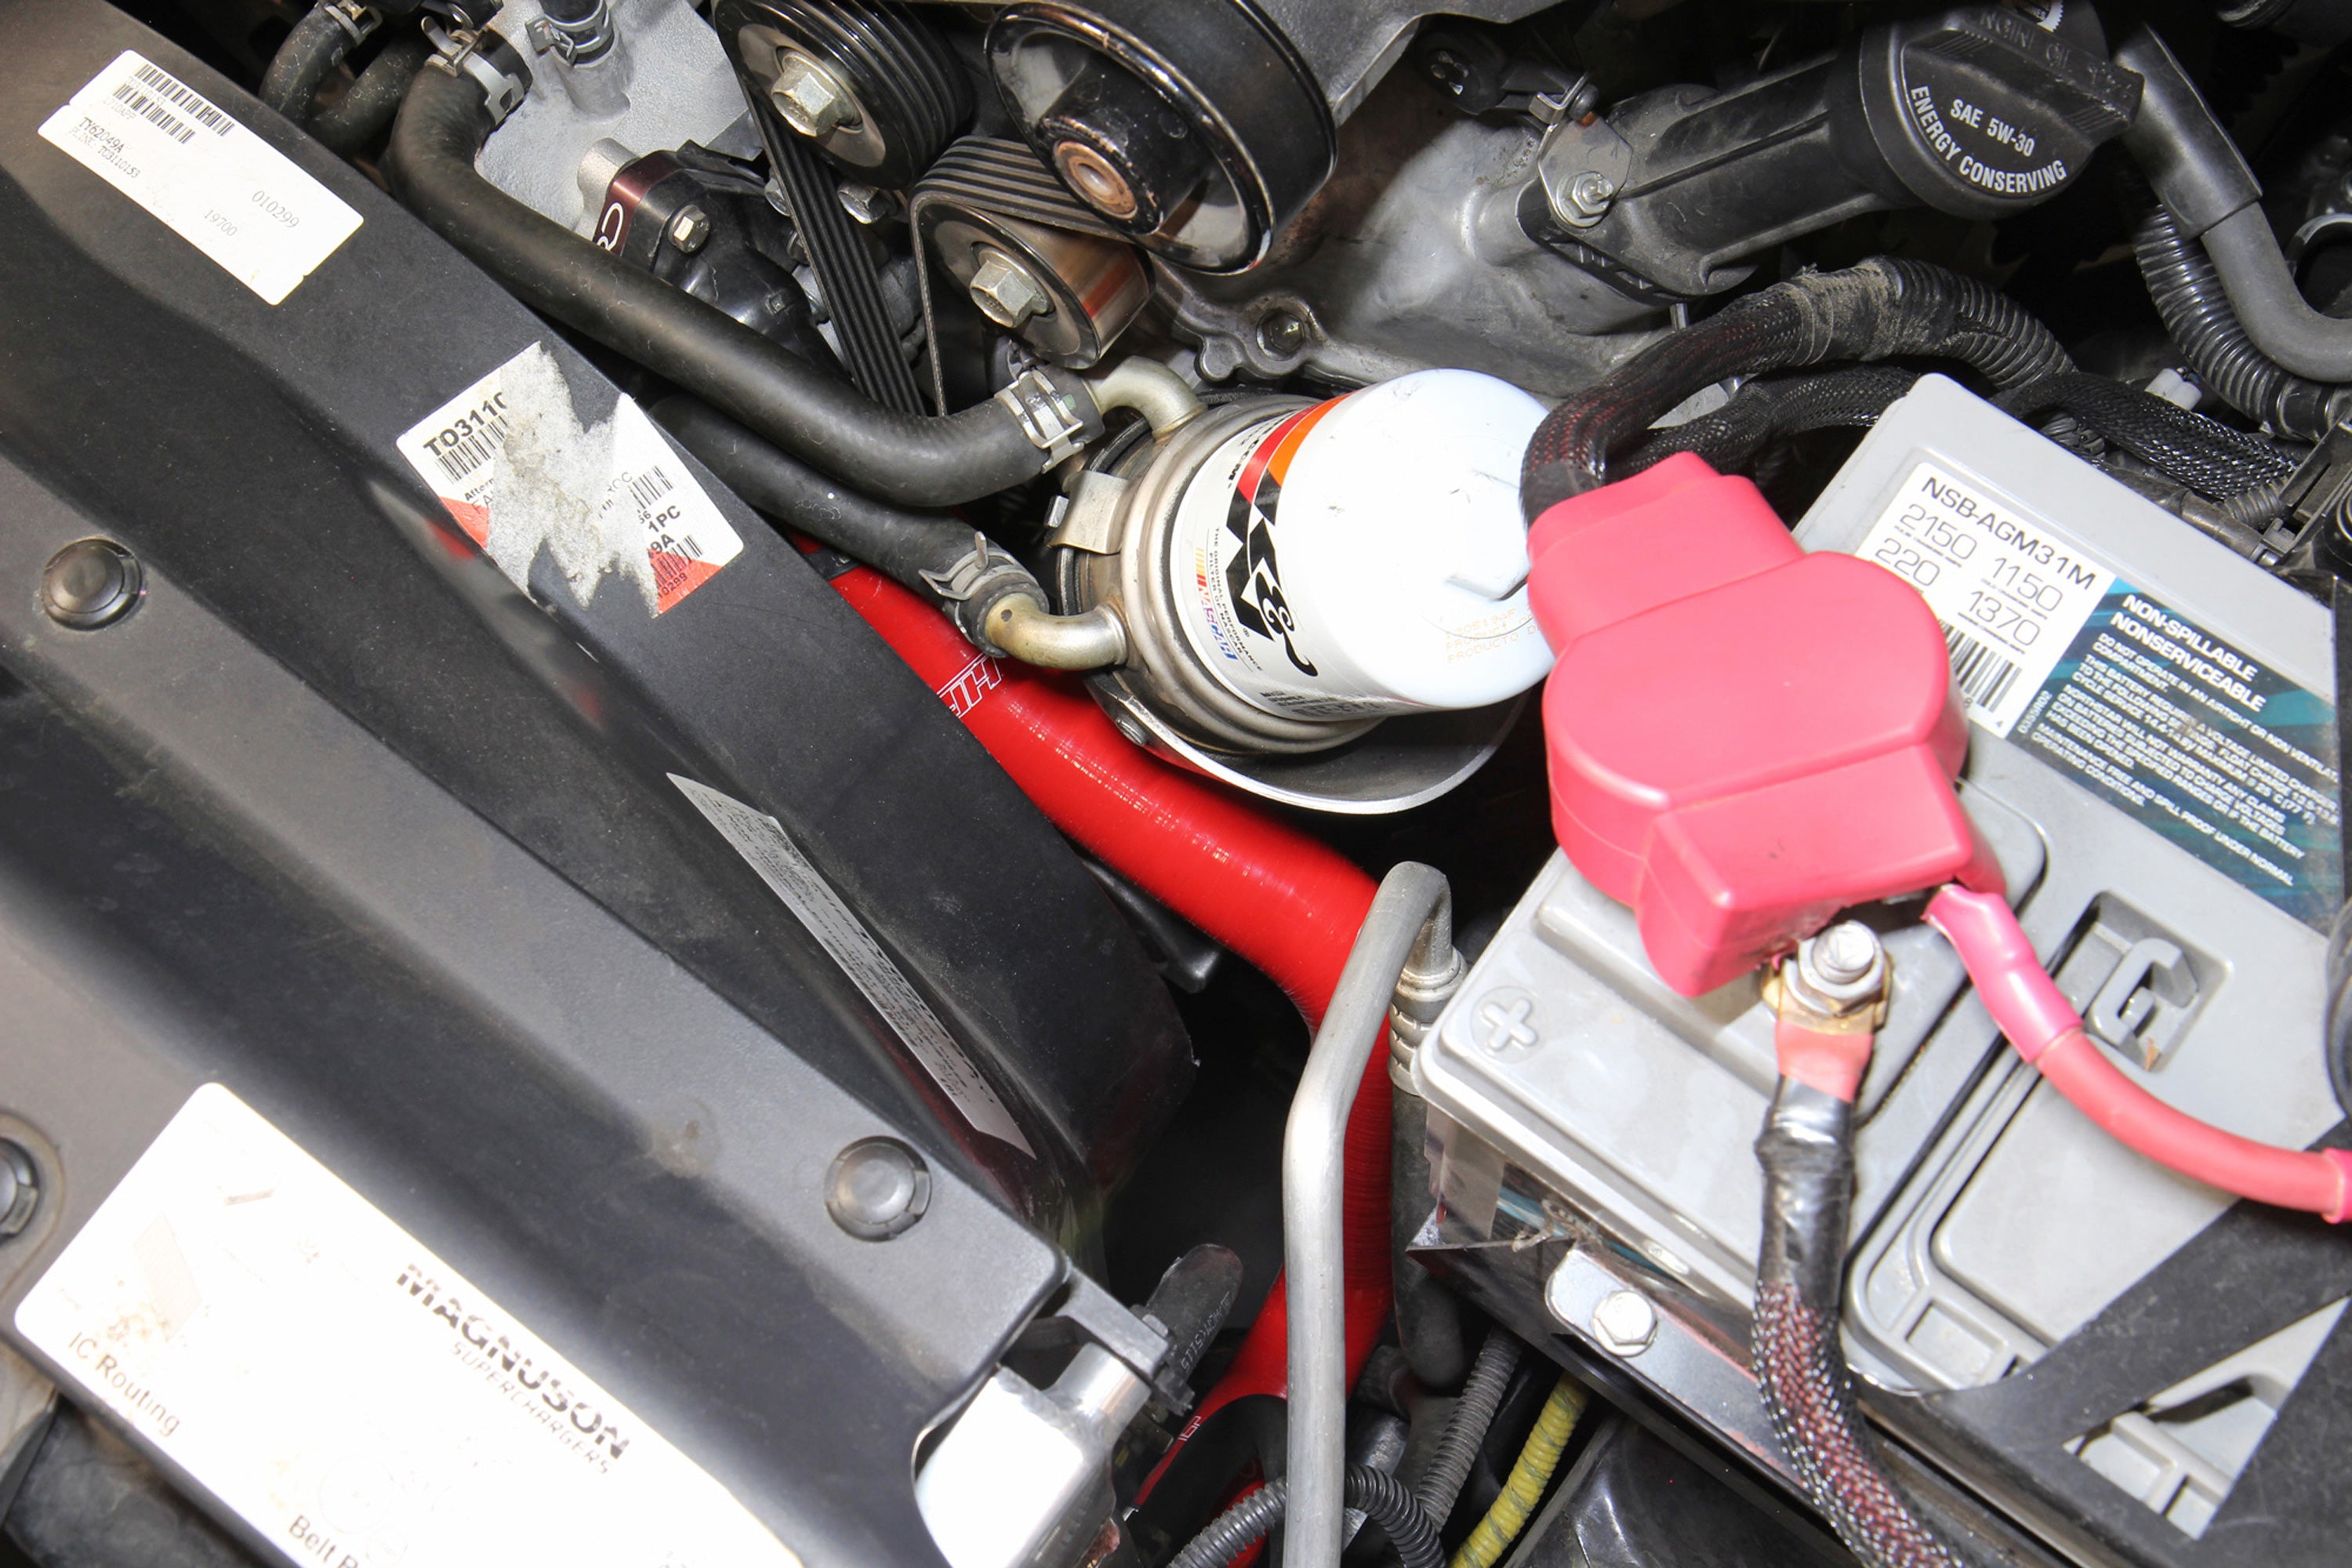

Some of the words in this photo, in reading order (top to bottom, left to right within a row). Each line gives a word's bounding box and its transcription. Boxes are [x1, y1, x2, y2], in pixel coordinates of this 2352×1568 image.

[78, 115, 125, 154] TY62049A
[1911, 85, 1962, 162] ENERGY
[1959, 155, 2067, 194] CONSERVING
[1949, 98, 1984, 129] SAE
[1987, 117, 2036, 158] 5W-30
[203, 207, 238, 238] 19700
[249, 188, 301, 231] 010299
[644, 503, 683, 535] 1PC
[1898, 500, 1980, 563] 2150
[1985, 553, 2064, 614] 1150
[1920, 474, 2096, 592] NSB-AGM31M
[1196, 575, 1238, 660] NASCAR
[1209, 552, 1218, 591] FILTER
[1215, 594, 1221, 608] OF
[1220, 612, 1243, 654] NASCAR
[1214, 550, 1224, 601] ORIGINAL
[1221, 603, 1263, 672] PERFORMANCE
[1874, 534, 1942, 589] 220
[1962, 586, 2042, 648] 1370
[2122, 591, 2258, 684] NON-SPILLABLE
[2091, 640, 2170, 693] COMPARTMENT.
[2097, 630, 2116, 648] DO
[2113, 640, 2137, 660] NOT
[2134, 653, 2180, 687] OPERATE
[2177, 679, 2192, 694] IN
[2189, 687, 2209, 704] AN
[2205, 696, 2252, 731] AIRTIGHT
[2248, 723, 2267, 740] OR
[2263, 732, 2292, 755] NON
[2109, 609, 2267, 713] NONSERVICEABLE
[1994, 718, 2003, 728] 4
[2030, 730, 2087, 770] OPERATING
[2083, 763, 2147, 807] CONDITIONS.
[2045, 709, 2069, 728] HAS
[2066, 722, 2095, 744] BEEN
[2092, 738, 2137, 770] OPENED.
[2056, 691, 2076, 708] ON
[2073, 701, 2126, 739] BATTERIES
[2123, 731, 2181, 772] SUBJECTED
[2178, 765, 2195, 781] TO
[2192, 774, 2235, 805] CHARGE
[2233, 799, 2286, 837] VOLTAGES
[2062, 682, 2124, 725] NORTHSTAR
[2121, 718, 2147, 739] WILL
[2144, 732, 2169, 753] NOT
[2166, 746, 2225, 787] WARRANTY
[2222, 780, 2248, 800] ANY
[2244, 793, 2286, 825] CLAIMS
[2071, 670, 2104, 695] CYCLE
[2101, 688, 2145, 720] SERVICE
[2193, 744, 2248, 783] MAXIMUM
[2078, 661, 2095, 677] TO
[2092, 670, 2114, 688] THE
[2111, 681, 2169, 722] FOLLOWING
[2216, 746, 2252, 773] FLOAT
[2248, 766, 2292, 797] CHARGE
[2083, 652, 2109, 673] THIS
[2105, 666, 2151, 699] BATTERY
[2195, 721, 2208, 734] A
[2206, 728, 2251, 760] VOLTAGE
[2248, 753, 2289, 784] LIMITED
[2035, 721, 2108, 771] MAINTENANCE
[2106, 764, 2133, 786] FREE
[2129, 779, 2156, 800] AND
[2152, 793, 2183, 817] SPILL
[2180, 809, 2216, 837] PROOF
[2213, 830, 2252, 858] UNDER
[2050, 699, 2107, 739] EXCEEDING
[2104, 732, 2126, 751] THE
[2123, 744, 2174, 780] SPECIFIED
[2171, 773, 2214, 805] RANGES
[2211, 798, 2230, 815] OR
[2227, 808, 2241, 821] IF
[2238, 814, 2260, 833] THE
[2258, 826, 2305, 861] BATTERY
[68, 1331, 97, 1359] IC
[95, 1354, 180, 1437] Routing
[394, 1261, 633, 1460] MAGNUSON
[449, 1340, 612, 1475] SUPERCHARGERS
[289, 1515, 336, 1562] Belt
